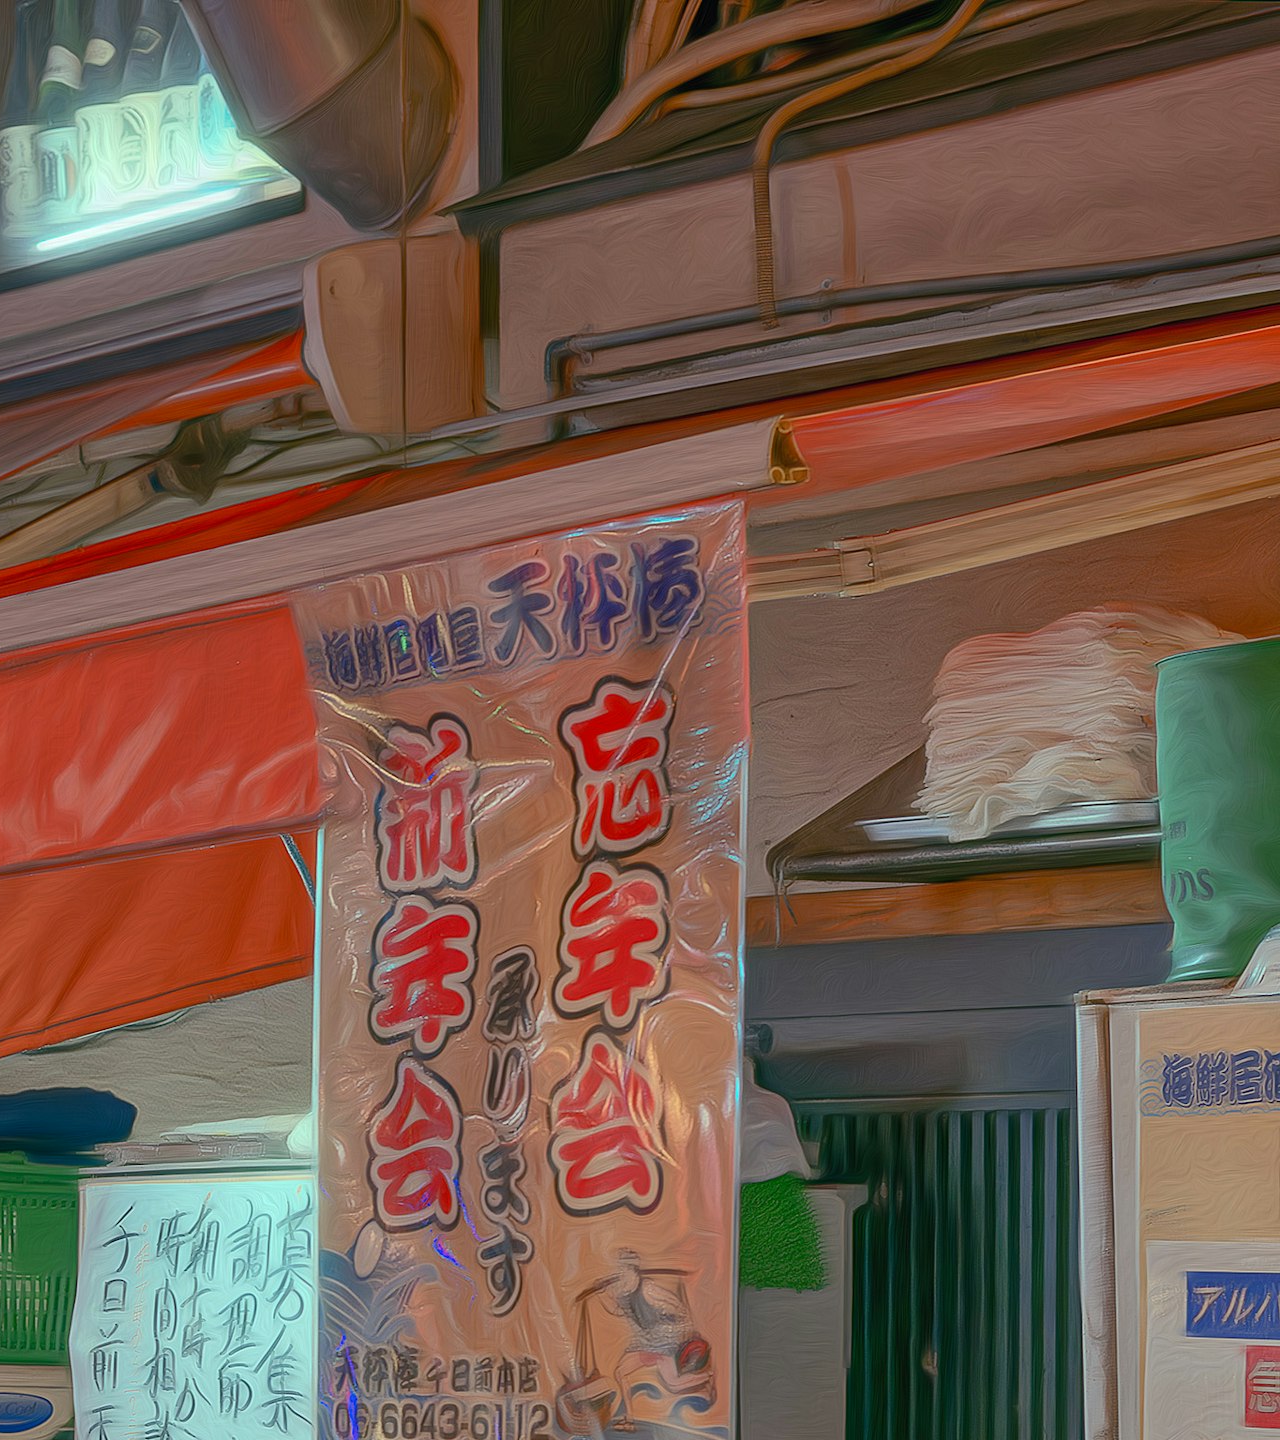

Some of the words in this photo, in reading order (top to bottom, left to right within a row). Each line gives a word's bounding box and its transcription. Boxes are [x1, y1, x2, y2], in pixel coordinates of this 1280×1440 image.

[376, 725, 470, 1217] 新年会
[559, 688, 668, 1206] 忘年会
[334, 1402, 550, 1440] 06-6643-6112
